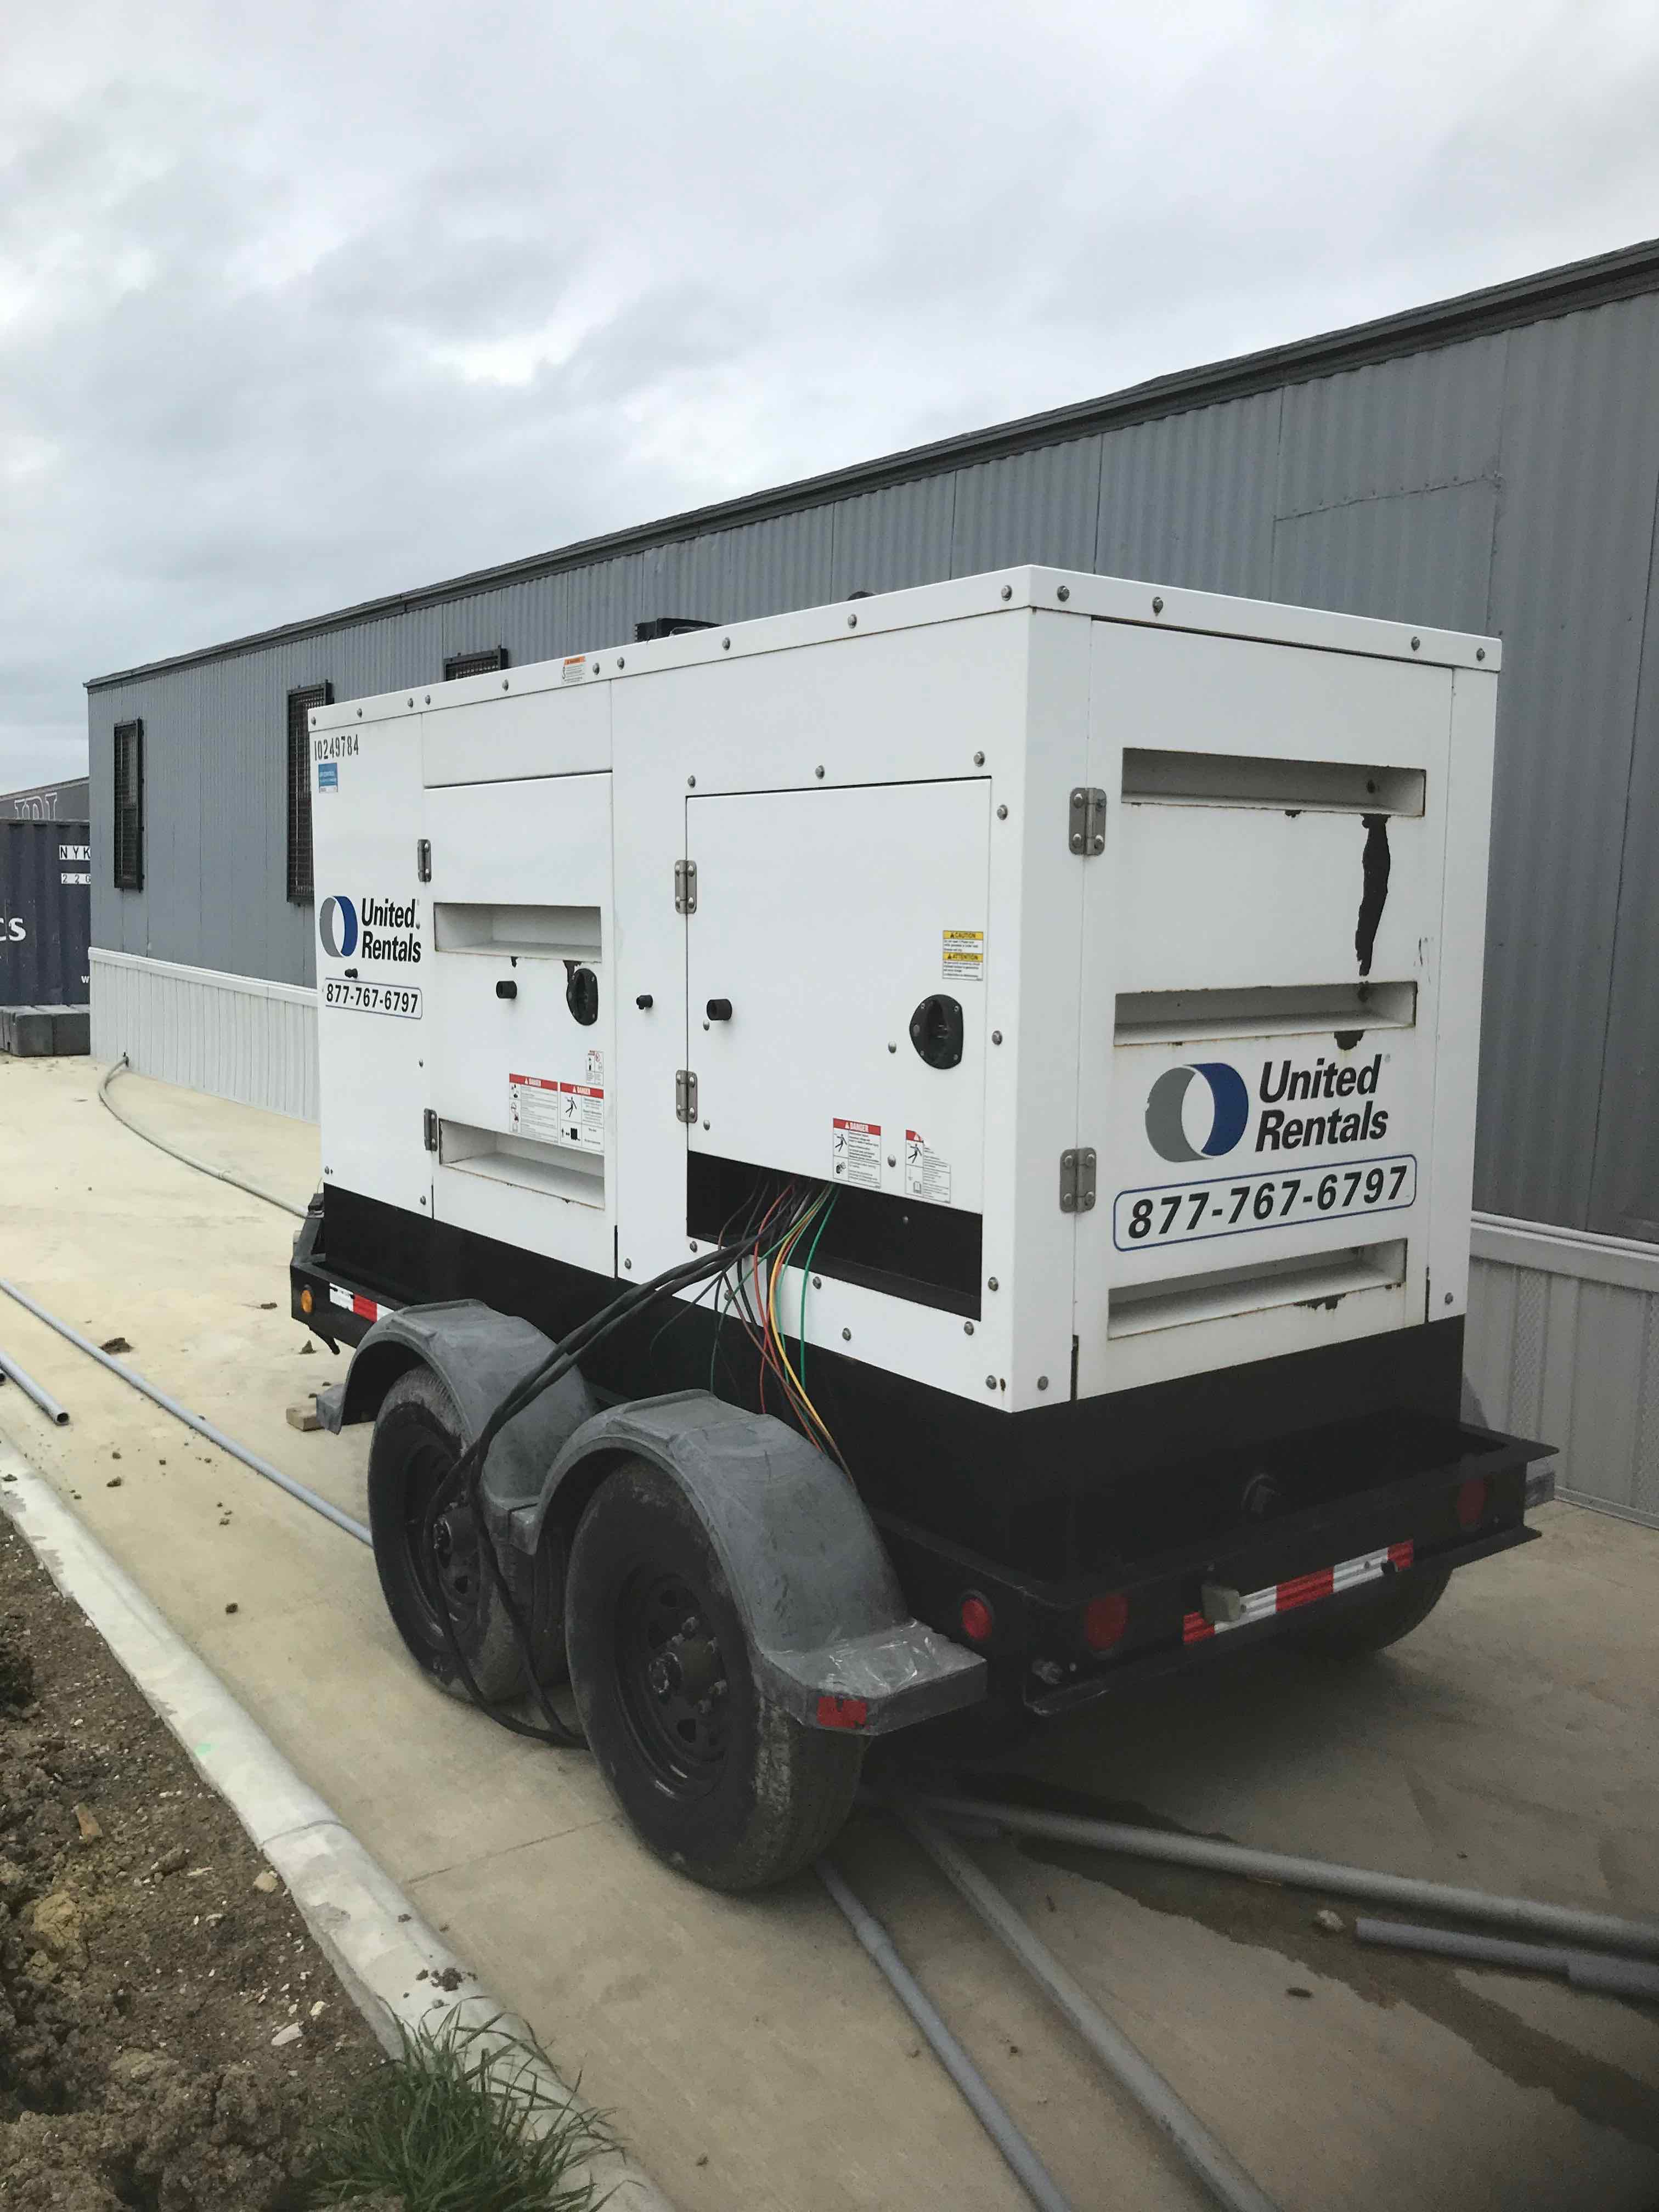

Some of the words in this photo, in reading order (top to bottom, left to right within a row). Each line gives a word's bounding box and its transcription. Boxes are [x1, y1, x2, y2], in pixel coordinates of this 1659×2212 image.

[314, 733, 359, 761] 10249784
[362, 898, 416, 928] United
[362, 930, 421, 963] Rentals
[326, 983, 418, 1014] 877-767-6797
[1259, 1053, 1382, 1103] United
[850, 1122, 869, 1133] DANGER
[1255, 1100, 1389, 1153] Rentals
[1127, 1165, 1408, 1239] 877-767-6797
